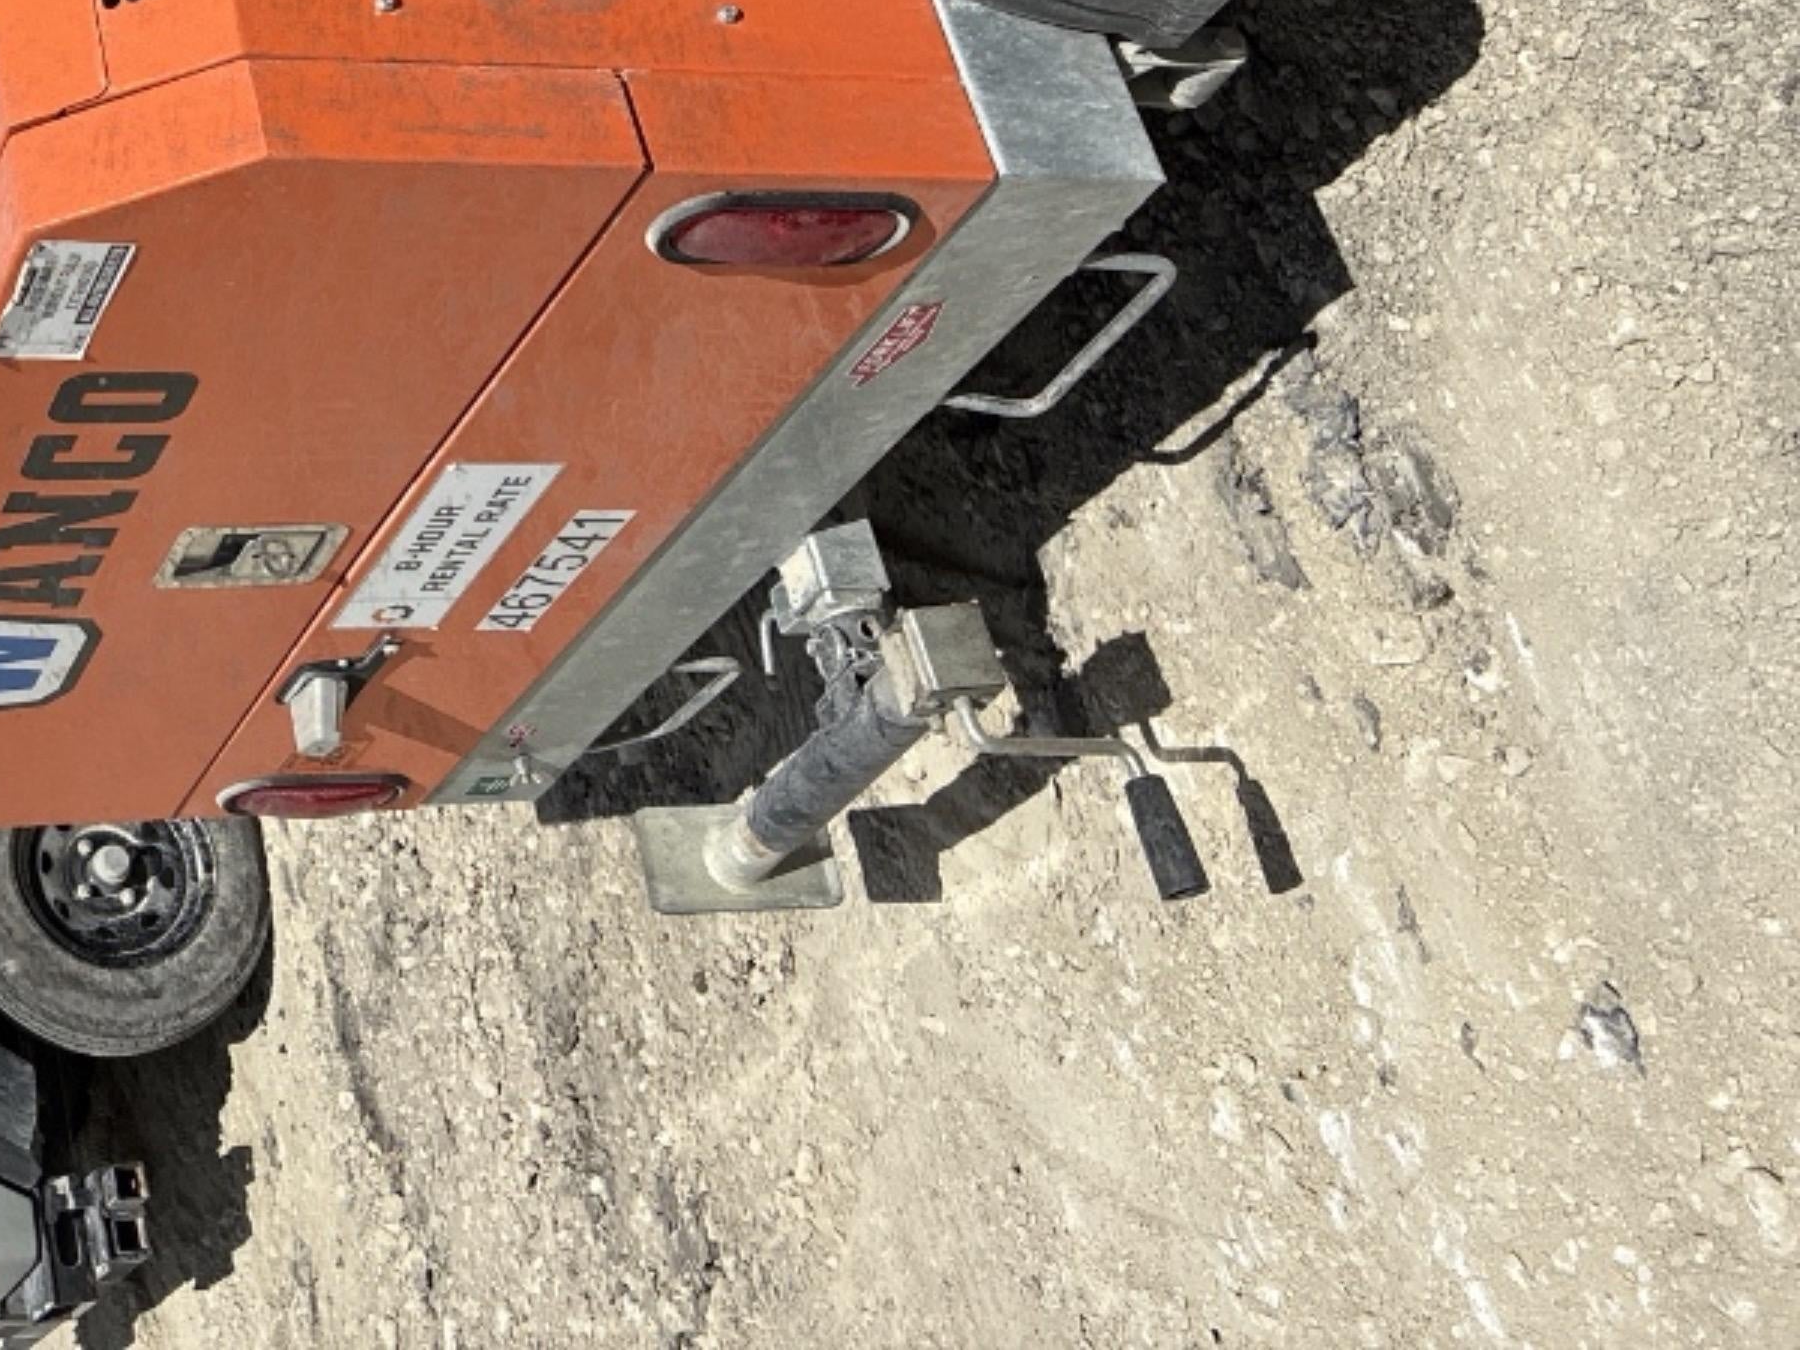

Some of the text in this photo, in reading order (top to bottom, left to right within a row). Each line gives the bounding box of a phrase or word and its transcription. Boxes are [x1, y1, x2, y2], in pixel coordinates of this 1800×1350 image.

[420, 474, 532, 592] RENTAL RATE
[488, 517, 625, 629] 467541
